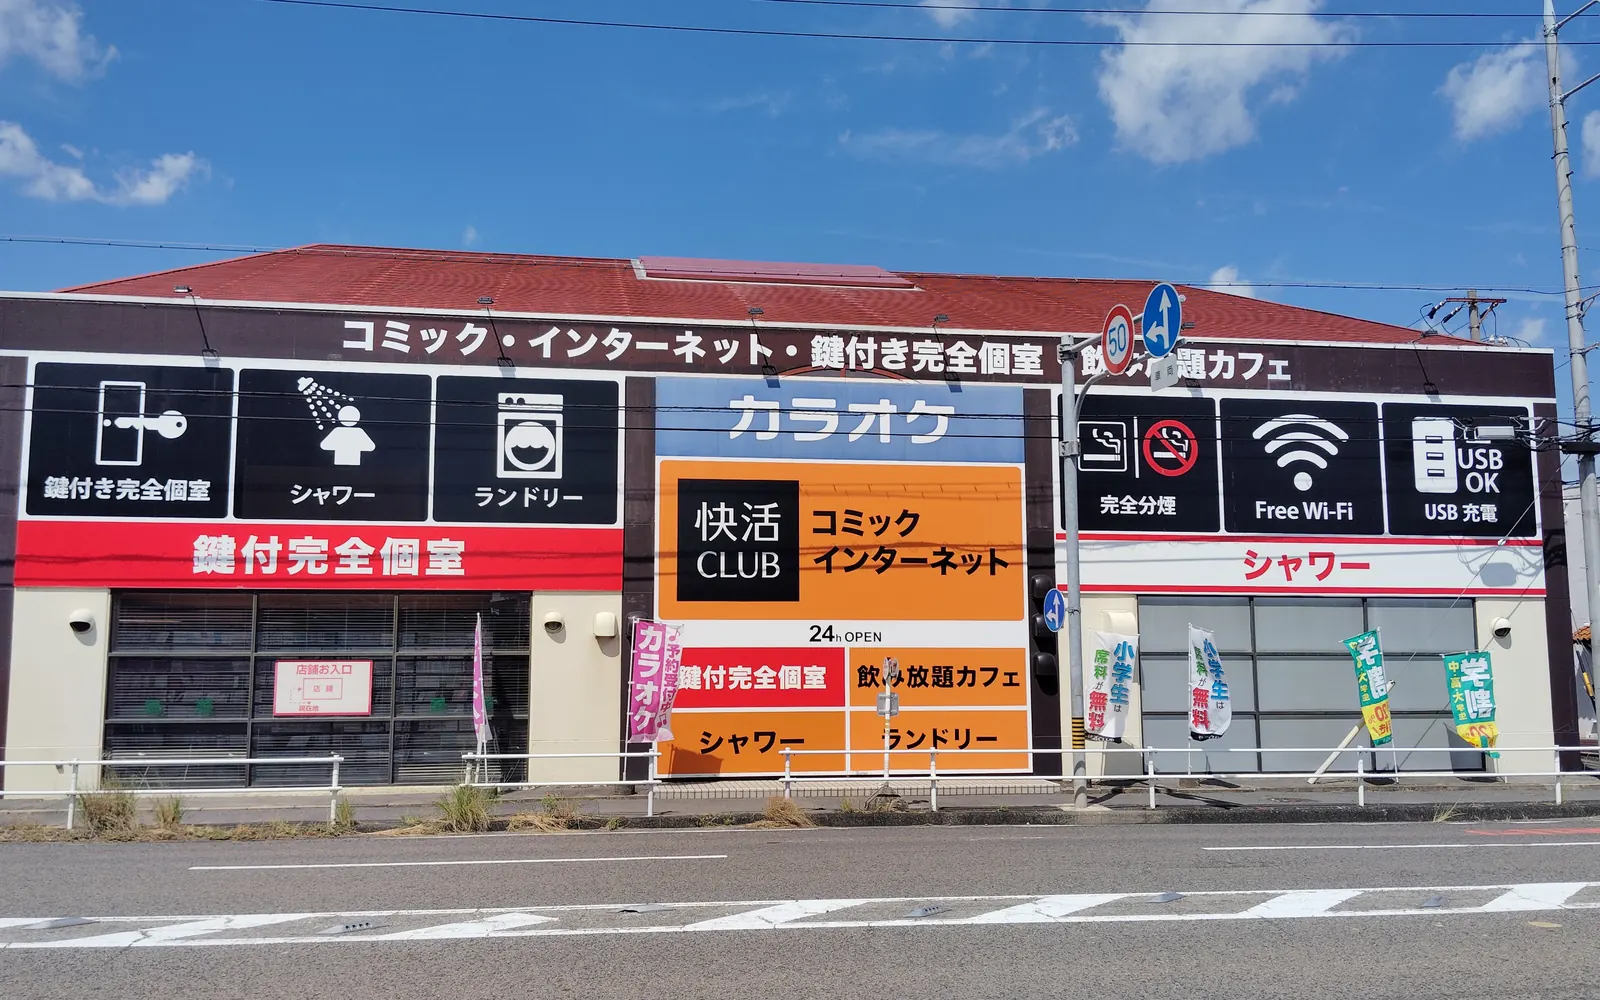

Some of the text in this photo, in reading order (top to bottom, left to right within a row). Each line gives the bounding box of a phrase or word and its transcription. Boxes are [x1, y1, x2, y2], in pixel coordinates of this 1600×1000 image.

[1108, 323, 1127, 357] 50
[728, 394, 956, 444] カラオケ
[1457, 448, 1504, 470] USB
[43, 476, 211, 502] 鍵付き完全個室
[290, 483, 376, 506] シャワー
[1465, 472, 1501, 493] OK
[474, 486, 584, 508] ランドリー
[1100, 495, 1177, 516] 完全分煙
[694, 501, 782, 542] 快活
[812, 509, 921, 538] コミック
[1255, 501, 1354, 521] Free Wi-Fi
[1424, 503, 1498, 523] USB 充電
[192, 534, 467, 577] 鍵付完全個室
[696, 550, 781, 579] CLUB
[812, 545, 1010, 577] インターネット
[1243, 549, 1371, 582] シャワー
[844, 631, 883, 643] OPEN
[296, 664, 353, 676] 店舗お入口
[633, 625, 663, 732] カラオケ
[679, 664, 827, 691] 鍵付完全個室
[1109, 640, 1135, 713] 小学生は
[699, 731, 805, 755] シャワー
[881, 727, 998, 750] ランドリー
